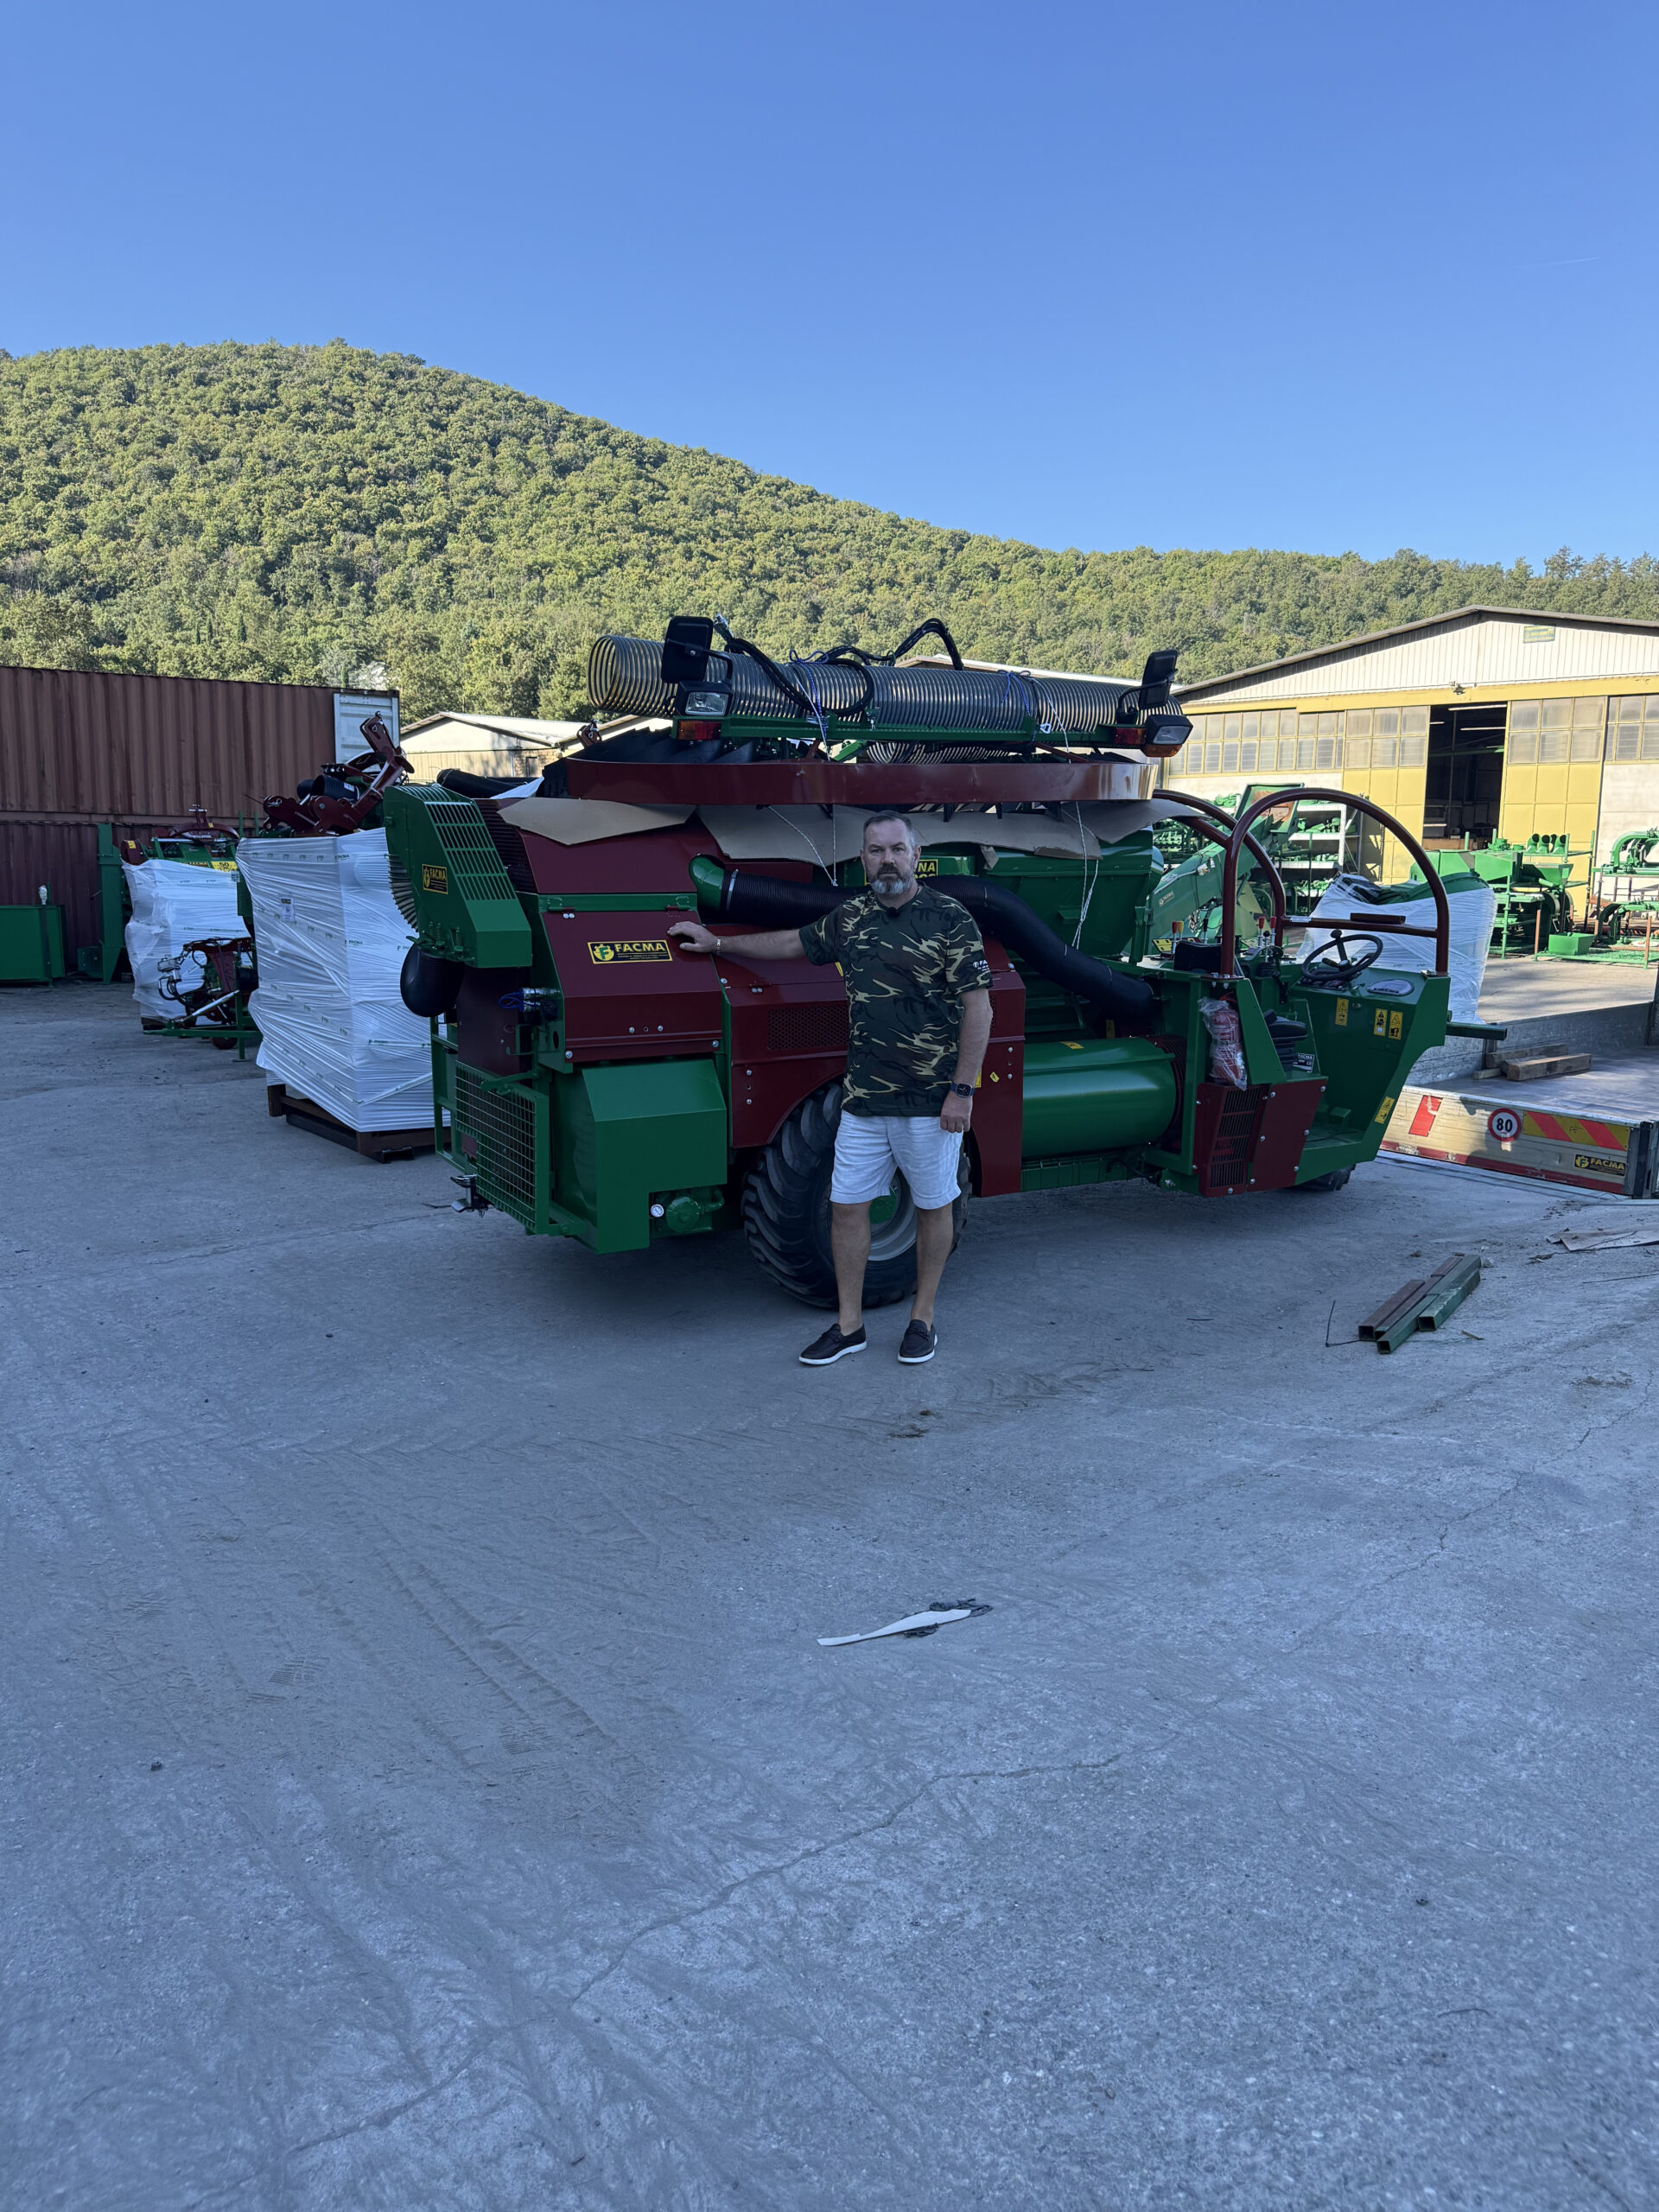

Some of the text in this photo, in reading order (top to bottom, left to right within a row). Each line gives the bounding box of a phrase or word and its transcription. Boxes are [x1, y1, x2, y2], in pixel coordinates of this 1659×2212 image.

[614, 943, 665, 952] FACMA
[1496, 1117, 1513, 1133] 80
[1590, 1158, 1625, 1171] FACMA
